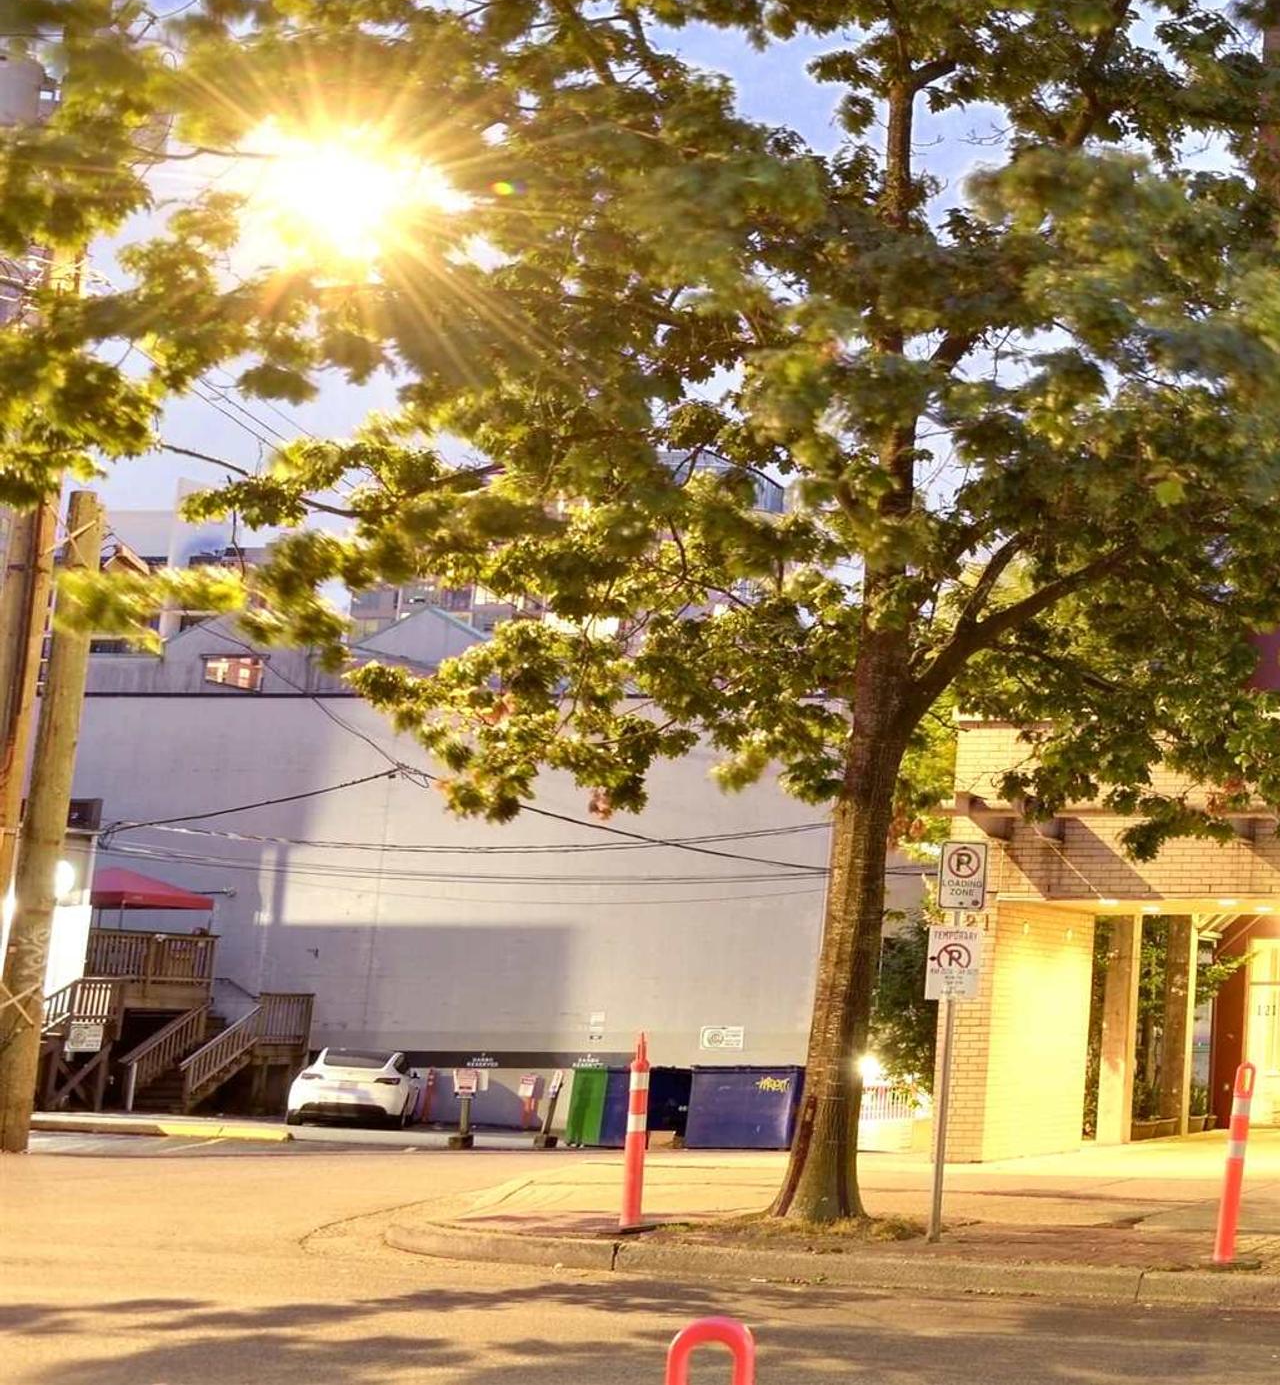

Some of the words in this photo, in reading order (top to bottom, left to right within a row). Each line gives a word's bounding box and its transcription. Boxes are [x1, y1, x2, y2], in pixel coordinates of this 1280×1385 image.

[941, 879, 983, 888] LOADING
[950, 887, 974, 896] ZONE
[934, 930, 978, 940] TEMPORARY
